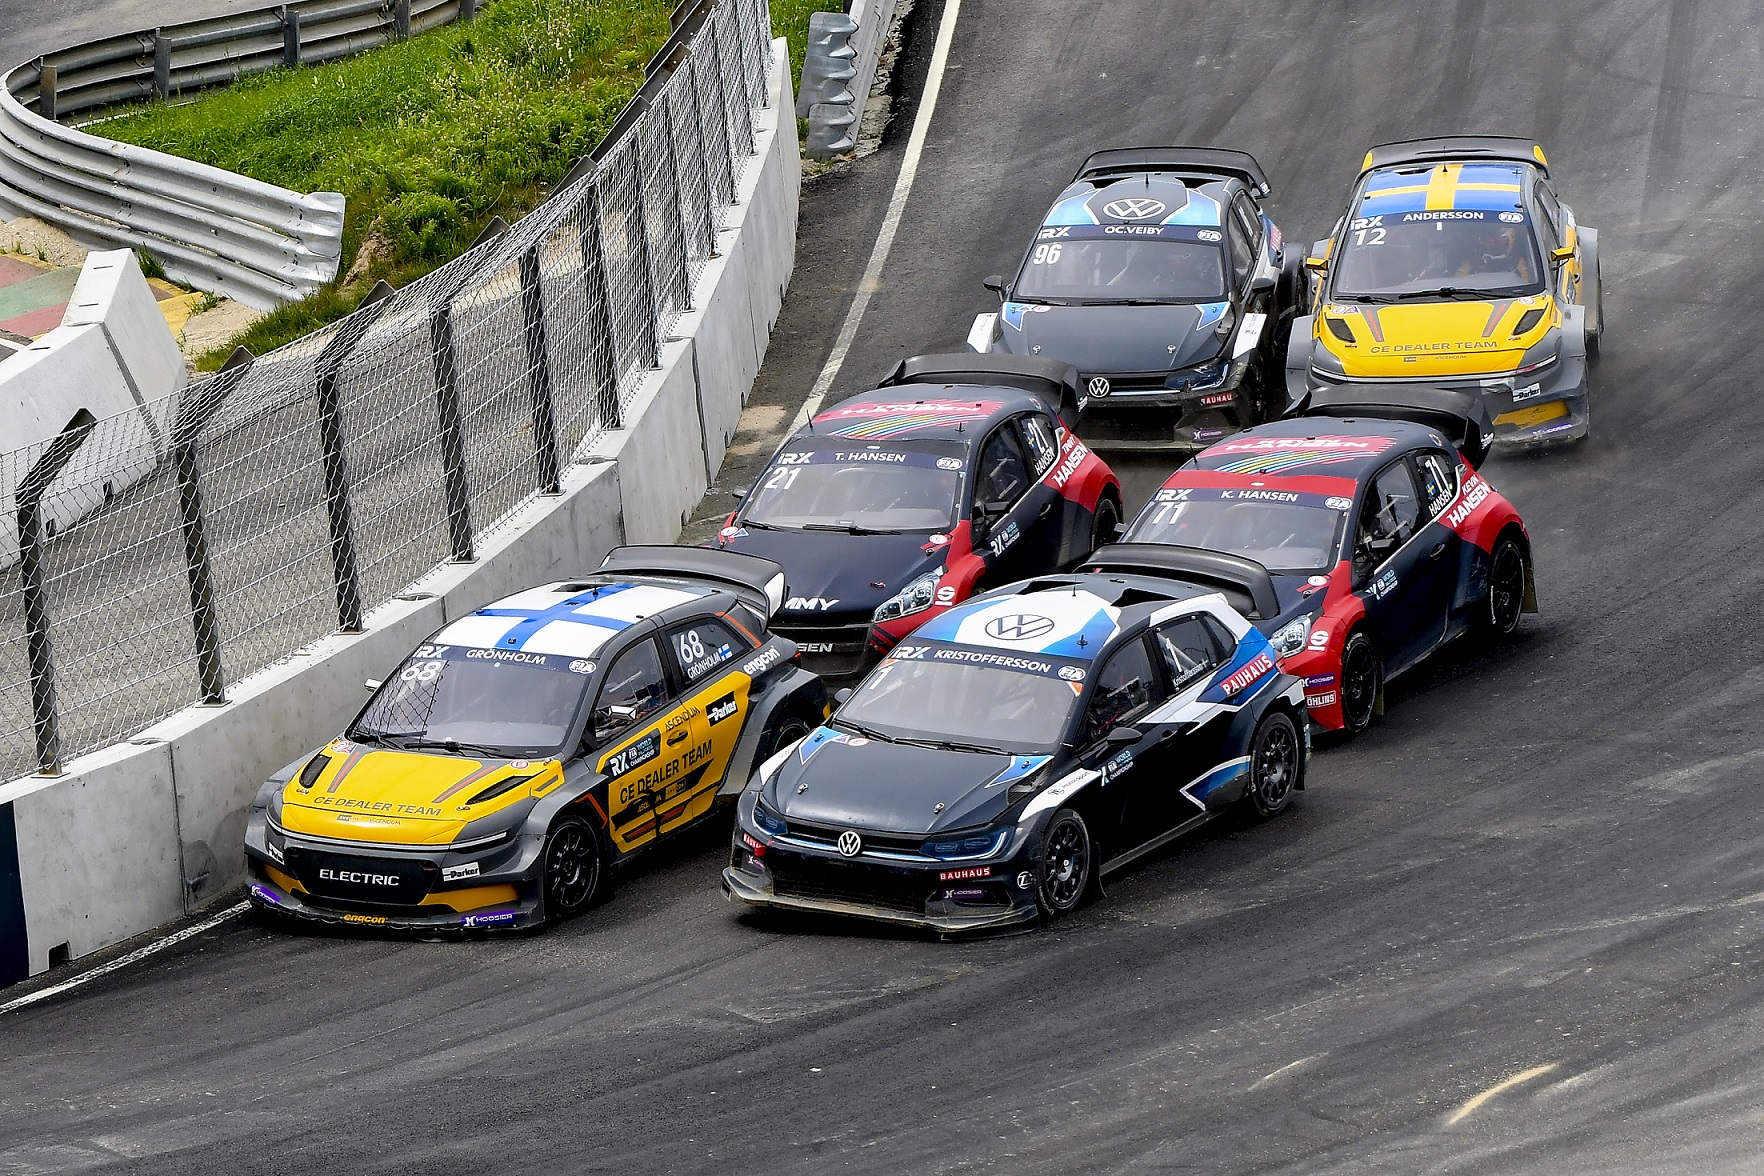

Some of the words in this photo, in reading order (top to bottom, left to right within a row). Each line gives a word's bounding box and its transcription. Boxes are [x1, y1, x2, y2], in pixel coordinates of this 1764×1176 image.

[1403, 211, 1484, 222] ANDERSSON
[1354, 227, 1387, 246] 12
[1033, 243, 1063, 265] 96
[1371, 345, 1391, 354] CE
[1394, 342, 1451, 352] DEALER
[1455, 340, 1498, 349] TEAM
[1028, 418, 1049, 454] 21
[834, 452, 844, 461] T.
[847, 453, 906, 463] HANSEN
[1034, 446, 1056, 476] HANSEN
[1052, 442, 1089, 487] HANSEN
[764, 467, 801, 490] 21
[1424, 456, 1449, 492] 71
[1462, 474, 1479, 495] KEVIN
[1220, 490, 1234, 499] K.
[1238, 491, 1299, 502] HANSEN
[1429, 489, 1453, 517] HANSEN
[1446, 481, 1491, 528] HANSEN
[1152, 501, 1189, 525] 71
[466, 648, 547, 665] GRÖNHOLM
[680, 630, 705, 663] 68
[400, 660, 441, 681] 68
[570, 660, 597, 675] FIA
[687, 652, 721, 680] GRÖNHOLM
[743, 645, 780, 675] engcon
[932, 649, 1052, 674] KRISTOFFERSSON
[868, 665, 894, 690] 1
[1059, 665, 1086, 681] FIA
[1172, 663, 1204, 687] Kristoffersson
[711, 700, 738, 721] Parker
[1306, 694, 1335, 706] ÖHLINS
[665, 706, 700, 733] ASCENDUM
[609, 752, 630, 776] RX
[620, 783, 634, 804] CE
[638, 759, 679, 795] DEALER
[682, 739, 713, 770] TEAM
[314, 796, 335, 805] CE
[335, 798, 393, 811] DEALER
[398, 804, 442, 816] TEAM
[319, 868, 400, 886] ELECTRIC
[448, 868, 479, 879] Parker
[940, 867, 990, 880] BAUHAUS
[343, 913, 387, 925] engcon
[476, 913, 513, 923] HOOSIER
